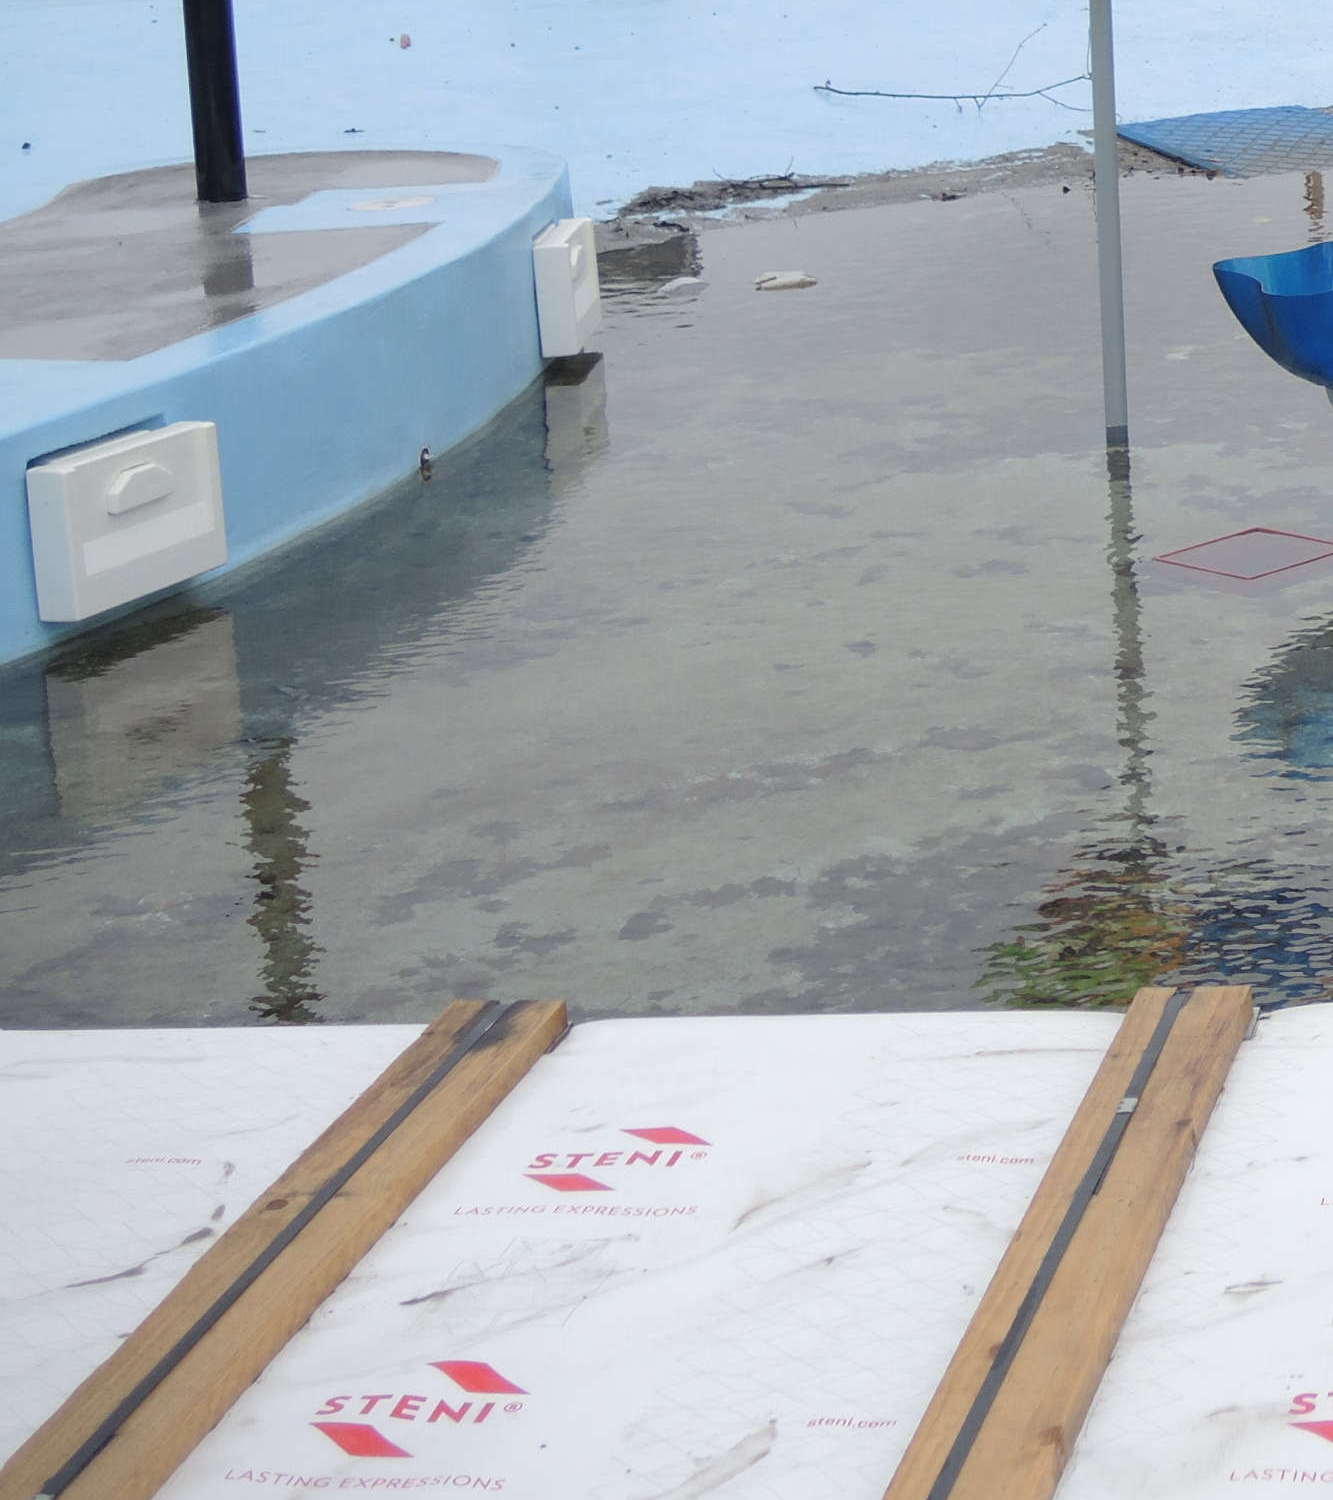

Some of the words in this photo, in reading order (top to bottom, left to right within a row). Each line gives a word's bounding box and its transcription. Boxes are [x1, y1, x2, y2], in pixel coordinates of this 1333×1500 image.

[124, 1155, 203, 1166] steni.com
[955, 1154, 1035, 1165] steni.com
[453, 1205, 547, 1216] LASTING
[552, 1204, 699, 1217] EXPRESSIONS
[806, 1416, 898, 1429] steni.com
[224, 1468, 333, 1489] LASTING
[338, 1474, 506, 1491] EXPRESSIONS
